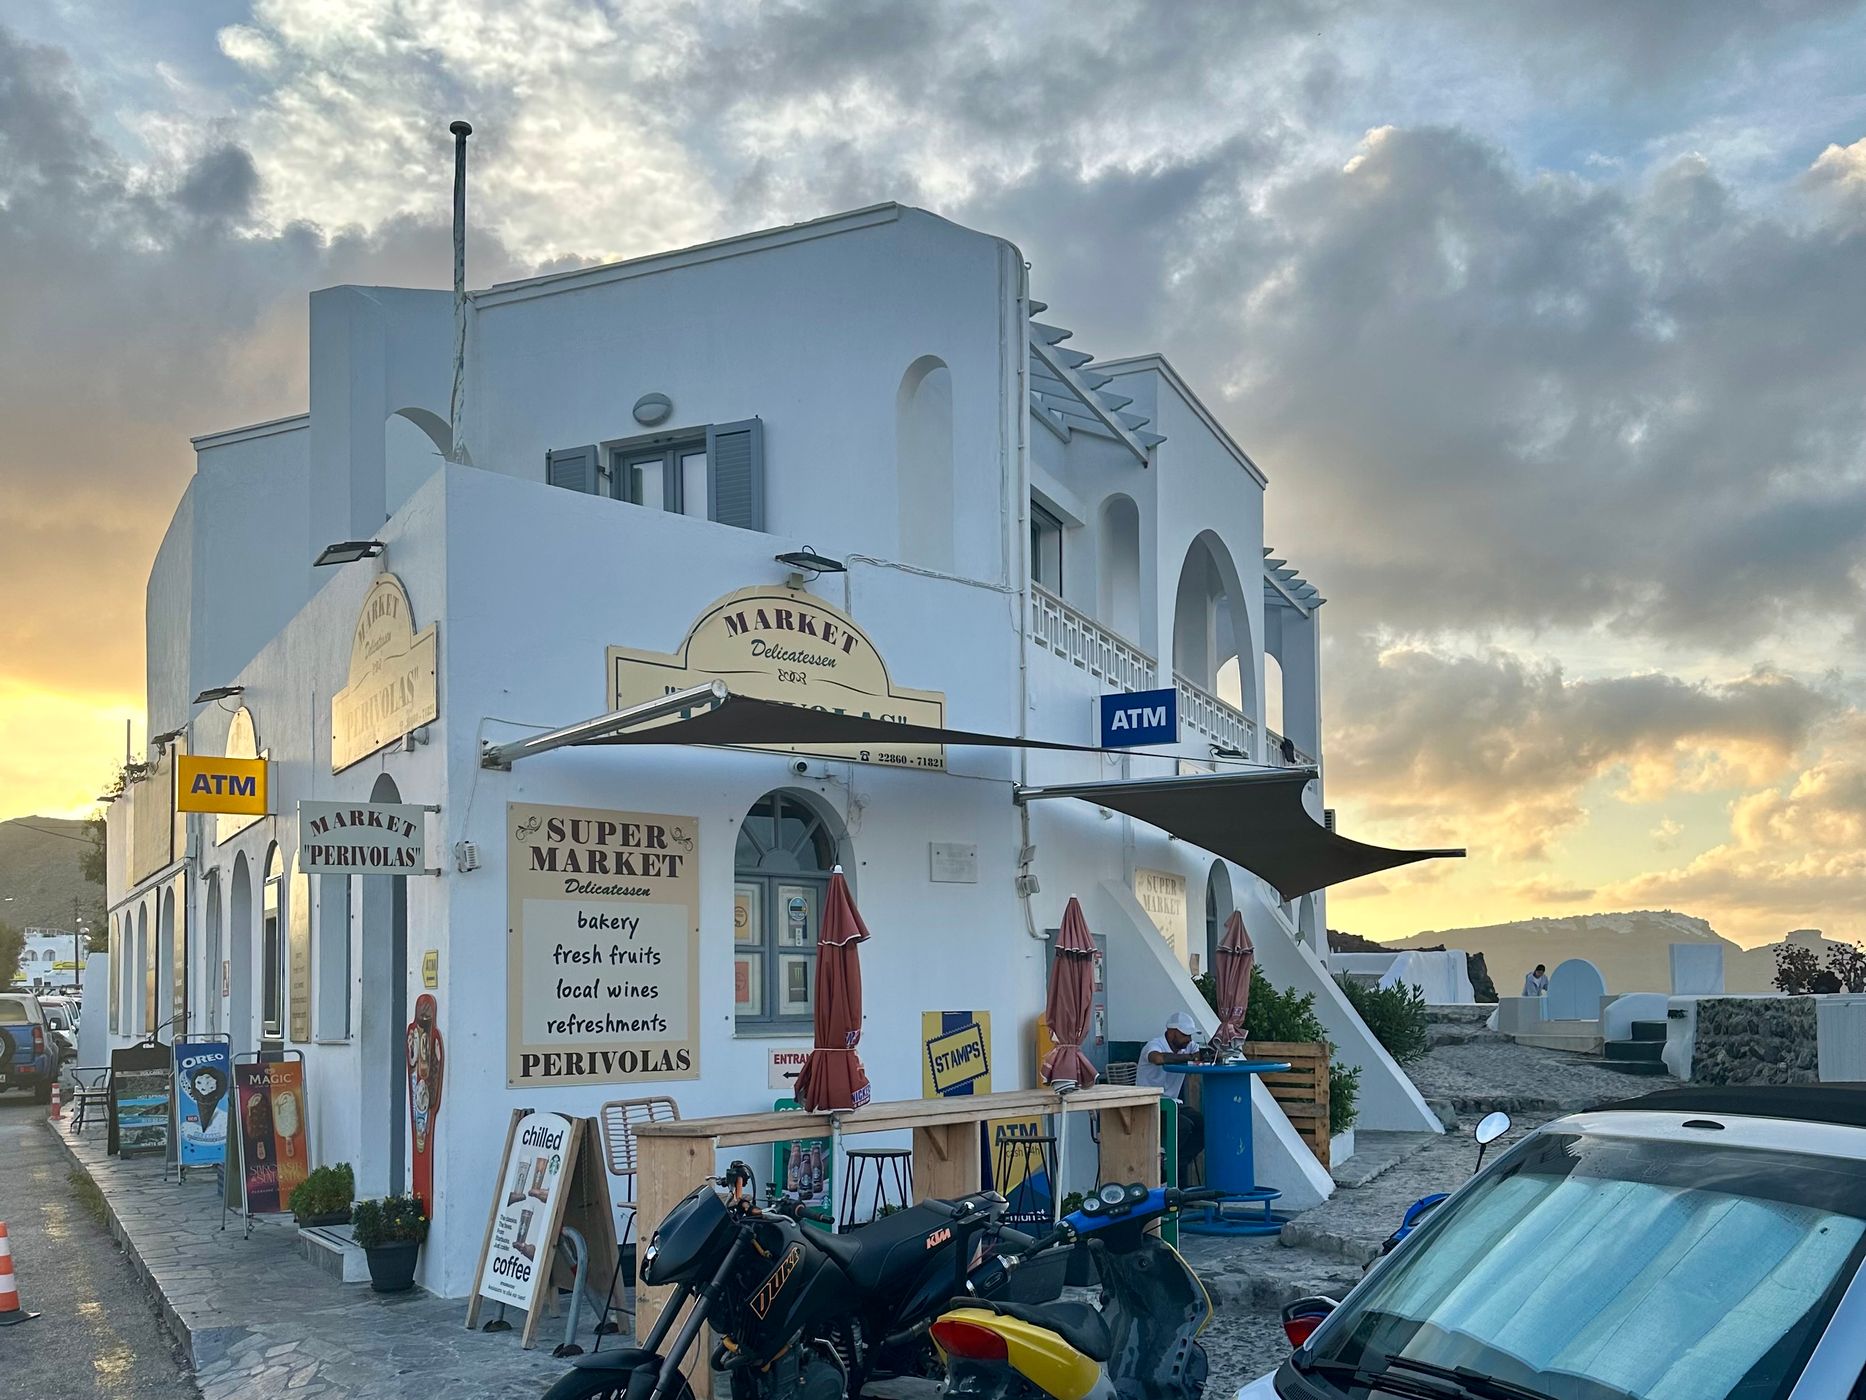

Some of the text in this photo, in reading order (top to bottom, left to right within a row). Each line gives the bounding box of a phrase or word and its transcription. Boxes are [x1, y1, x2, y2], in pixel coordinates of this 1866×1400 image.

[358, 593, 399, 644] MARKET
[723, 608, 858, 655] MARKET
[751, 638, 837, 668] Delicatessen
[1111, 706, 1166, 731] ATM
[878, 753, 907, 764] 22860
[917, 757, 943, 768] 71821
[190, 773, 256, 797] ATM
[309, 809, 417, 839] MARKET
[547, 817, 668, 849] SUPER
[304, 844, 421, 868] "PERIVOLAS"
[528, 846, 683, 878] MARKET
[564, 878, 651, 897] Delicatessen
[1146, 874, 1177, 896] SUPER
[1143, 894, 1180, 915] MARKET
[577, 910, 640, 940] bakery
[553, 943, 661, 965] fresh fruits
[556, 978, 659, 999] local wines
[547, 1012, 667, 1035] refreshments
[182, 1053, 224, 1068] OREO
[519, 1048, 691, 1078] PERIVOLAS
[934, 1041, 981, 1073] STAMPS
[249, 1073, 292, 1086] MAGIC
[522, 1125, 563, 1151] chilled
[995, 1123, 1038, 1146] ATM
[926, 1228, 951, 1250] KTM
[493, 1256, 531, 1283] coffee
